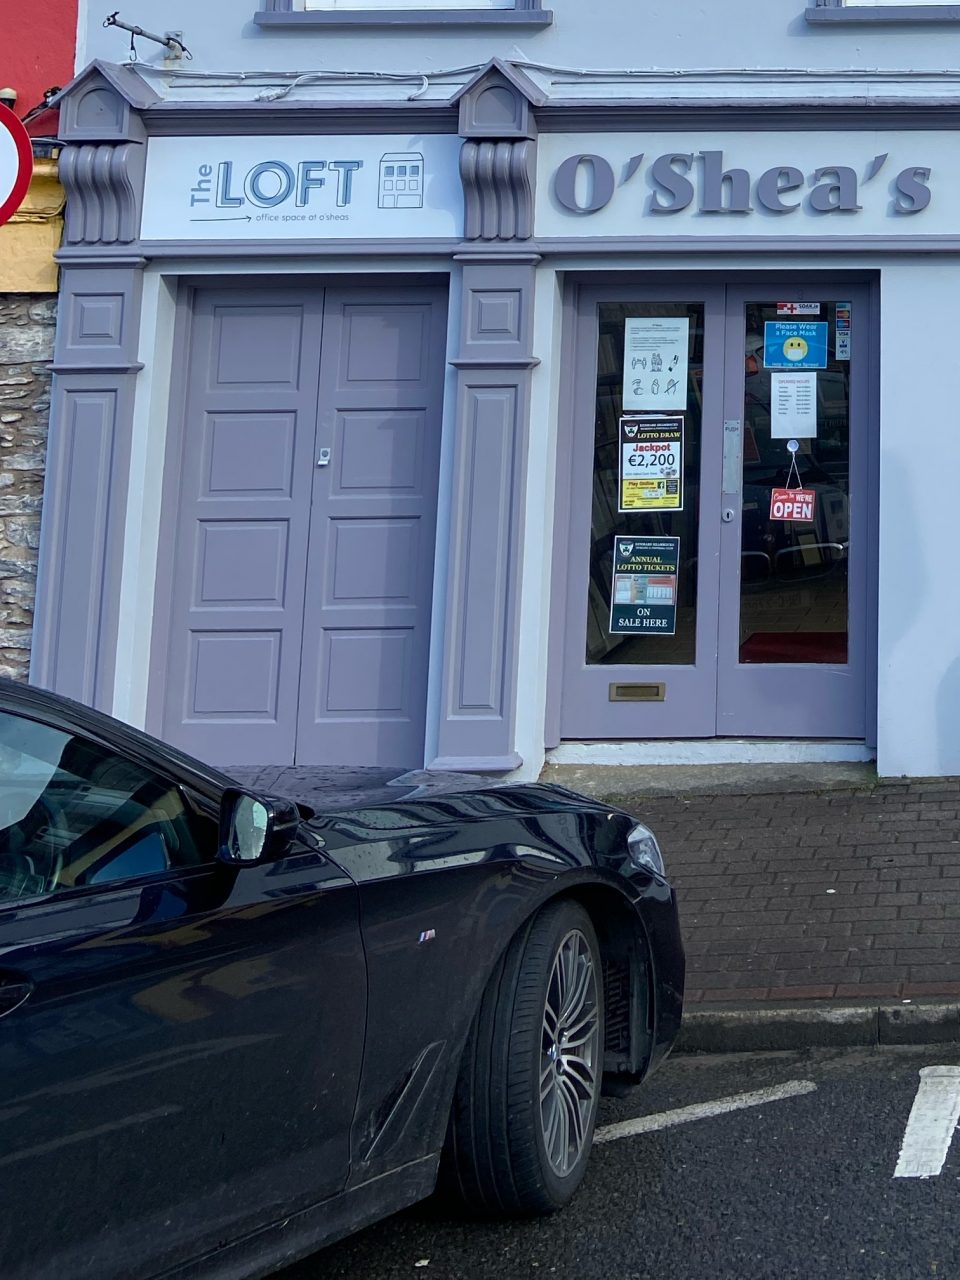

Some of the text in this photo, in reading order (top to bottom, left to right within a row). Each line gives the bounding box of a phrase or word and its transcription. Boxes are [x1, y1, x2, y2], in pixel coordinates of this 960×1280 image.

[190, 160, 364, 209] The LOFT
[553, 150, 932, 214] O'Shea's
[256, 213, 279, 222] office
[282, 215, 306, 223] space
[308, 213, 317, 221] at
[633, 443, 671, 453] Jackpot
[628, 453, 675, 469] €2,200
[795, 493, 813, 502] WE'RE
[773, 501, 812, 519] OPEN
[617, 563, 676, 572] LOTTO TICKETS
[636, 607, 651, 616] ON
[618, 618, 668, 627] SALE HERE
